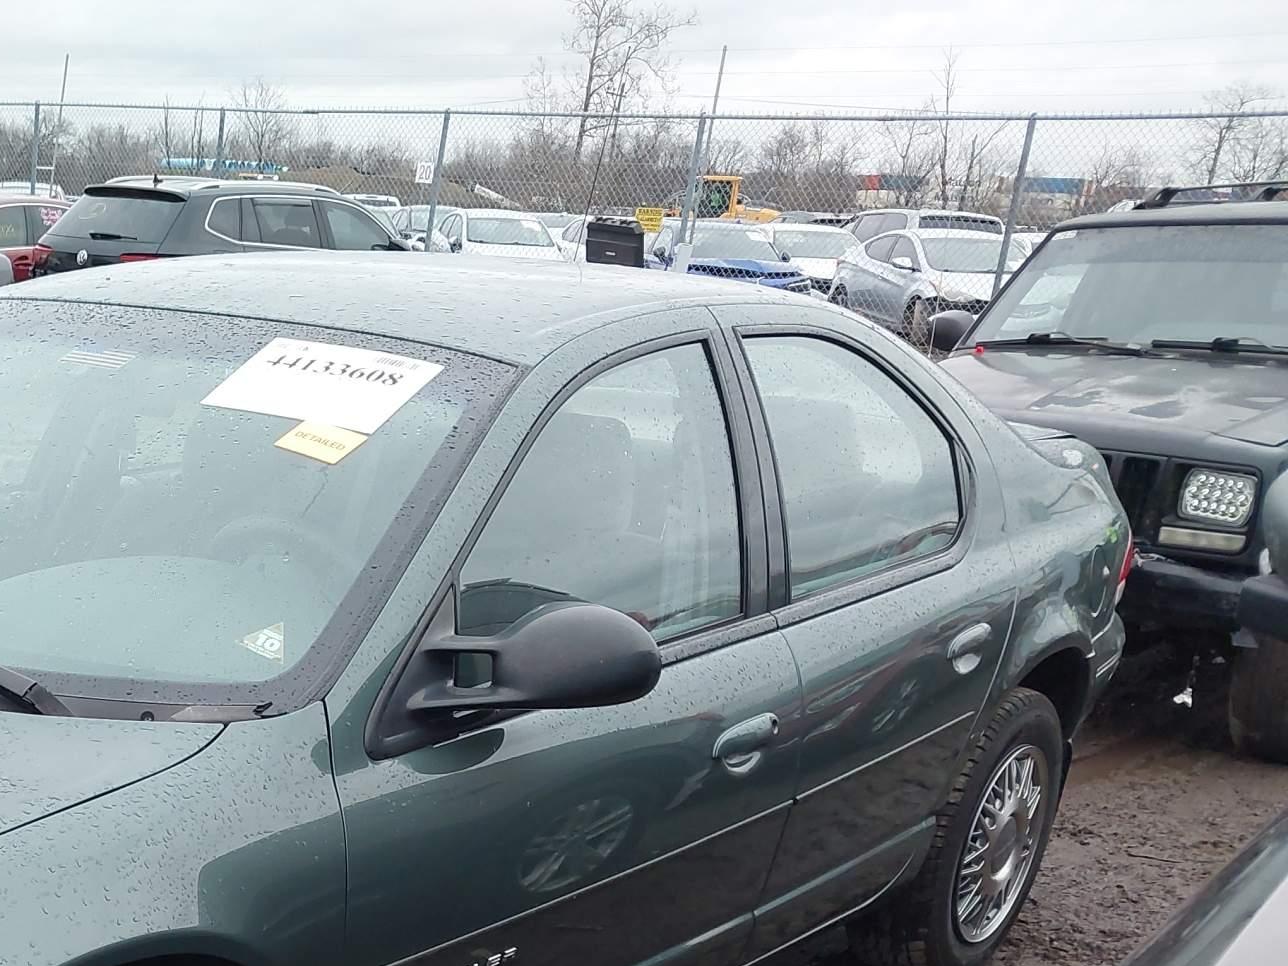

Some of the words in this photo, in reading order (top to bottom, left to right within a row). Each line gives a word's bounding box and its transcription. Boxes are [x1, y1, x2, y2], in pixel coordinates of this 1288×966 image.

[418, 164, 432, 180] 20
[265, 354, 404, 386] 44133608
[293, 430, 347, 451] DETAILED
